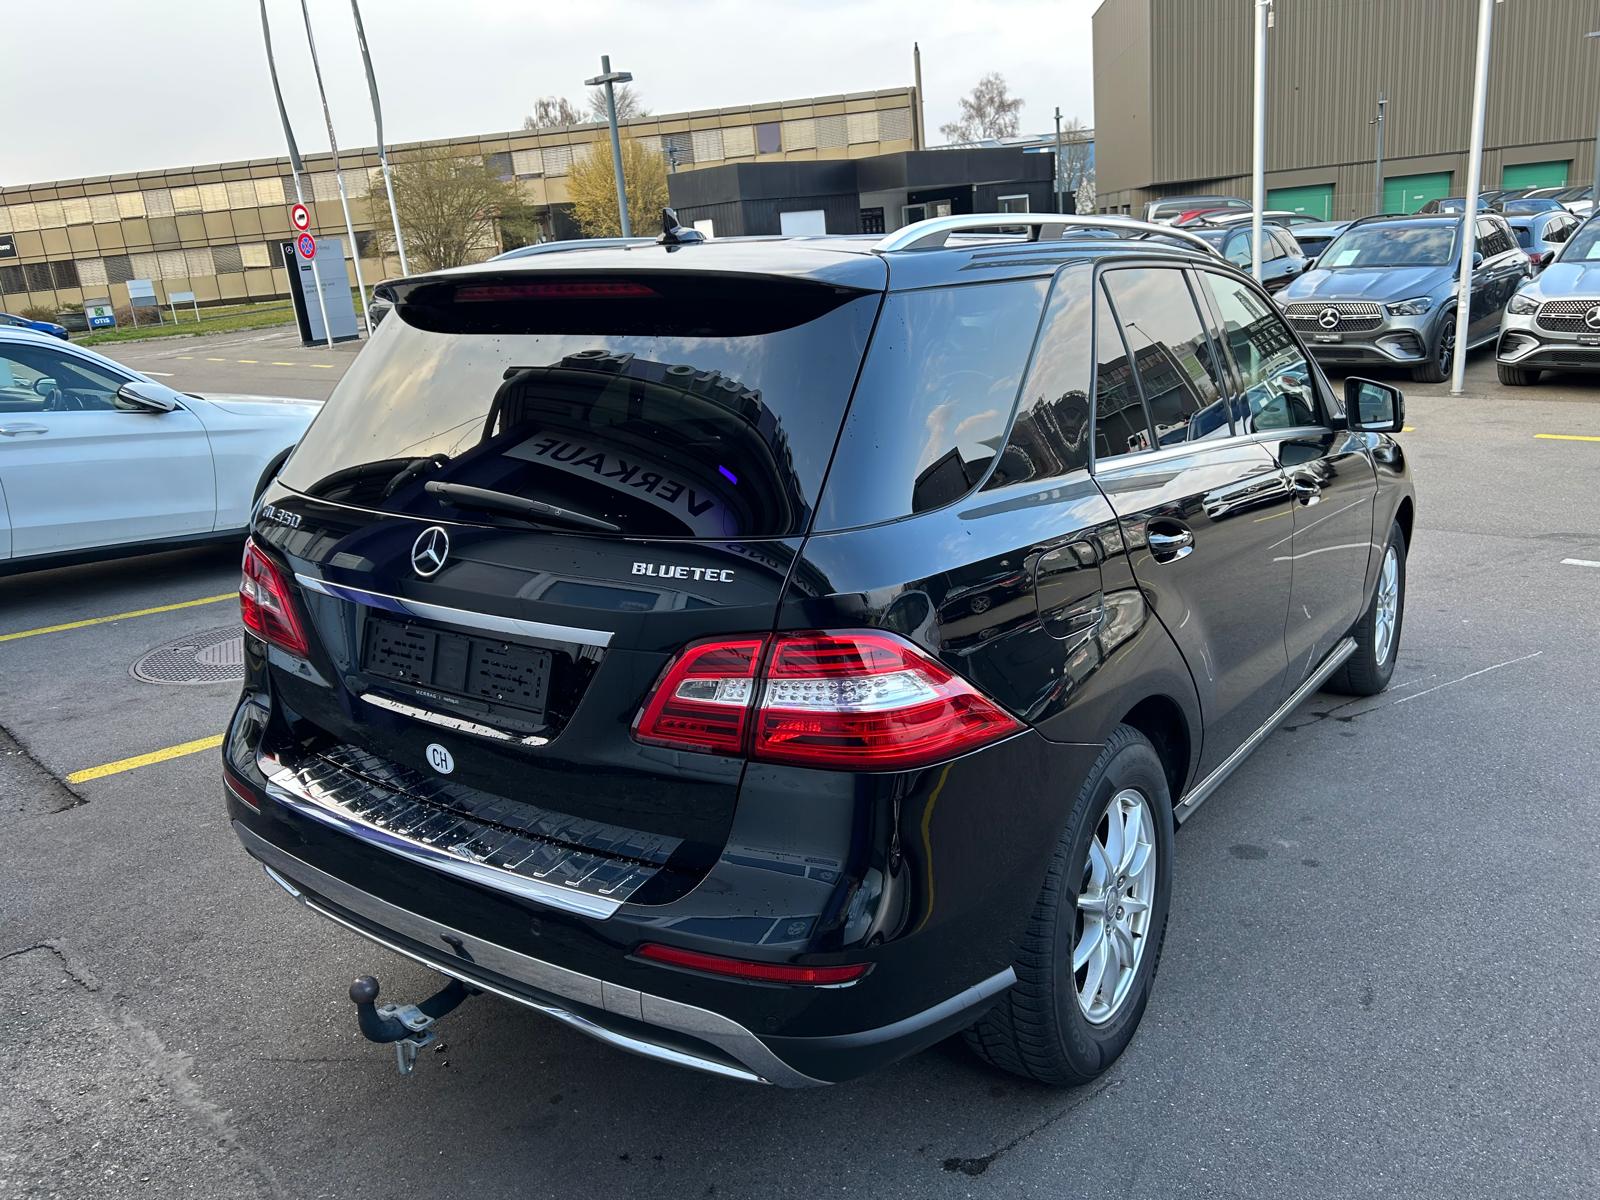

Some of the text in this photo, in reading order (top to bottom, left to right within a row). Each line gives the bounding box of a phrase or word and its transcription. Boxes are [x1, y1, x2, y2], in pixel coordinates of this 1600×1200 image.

[94, 317, 110, 325] OTIS
[632, 562, 735, 583] BLUETEC
[432, 748, 449, 770] CH
